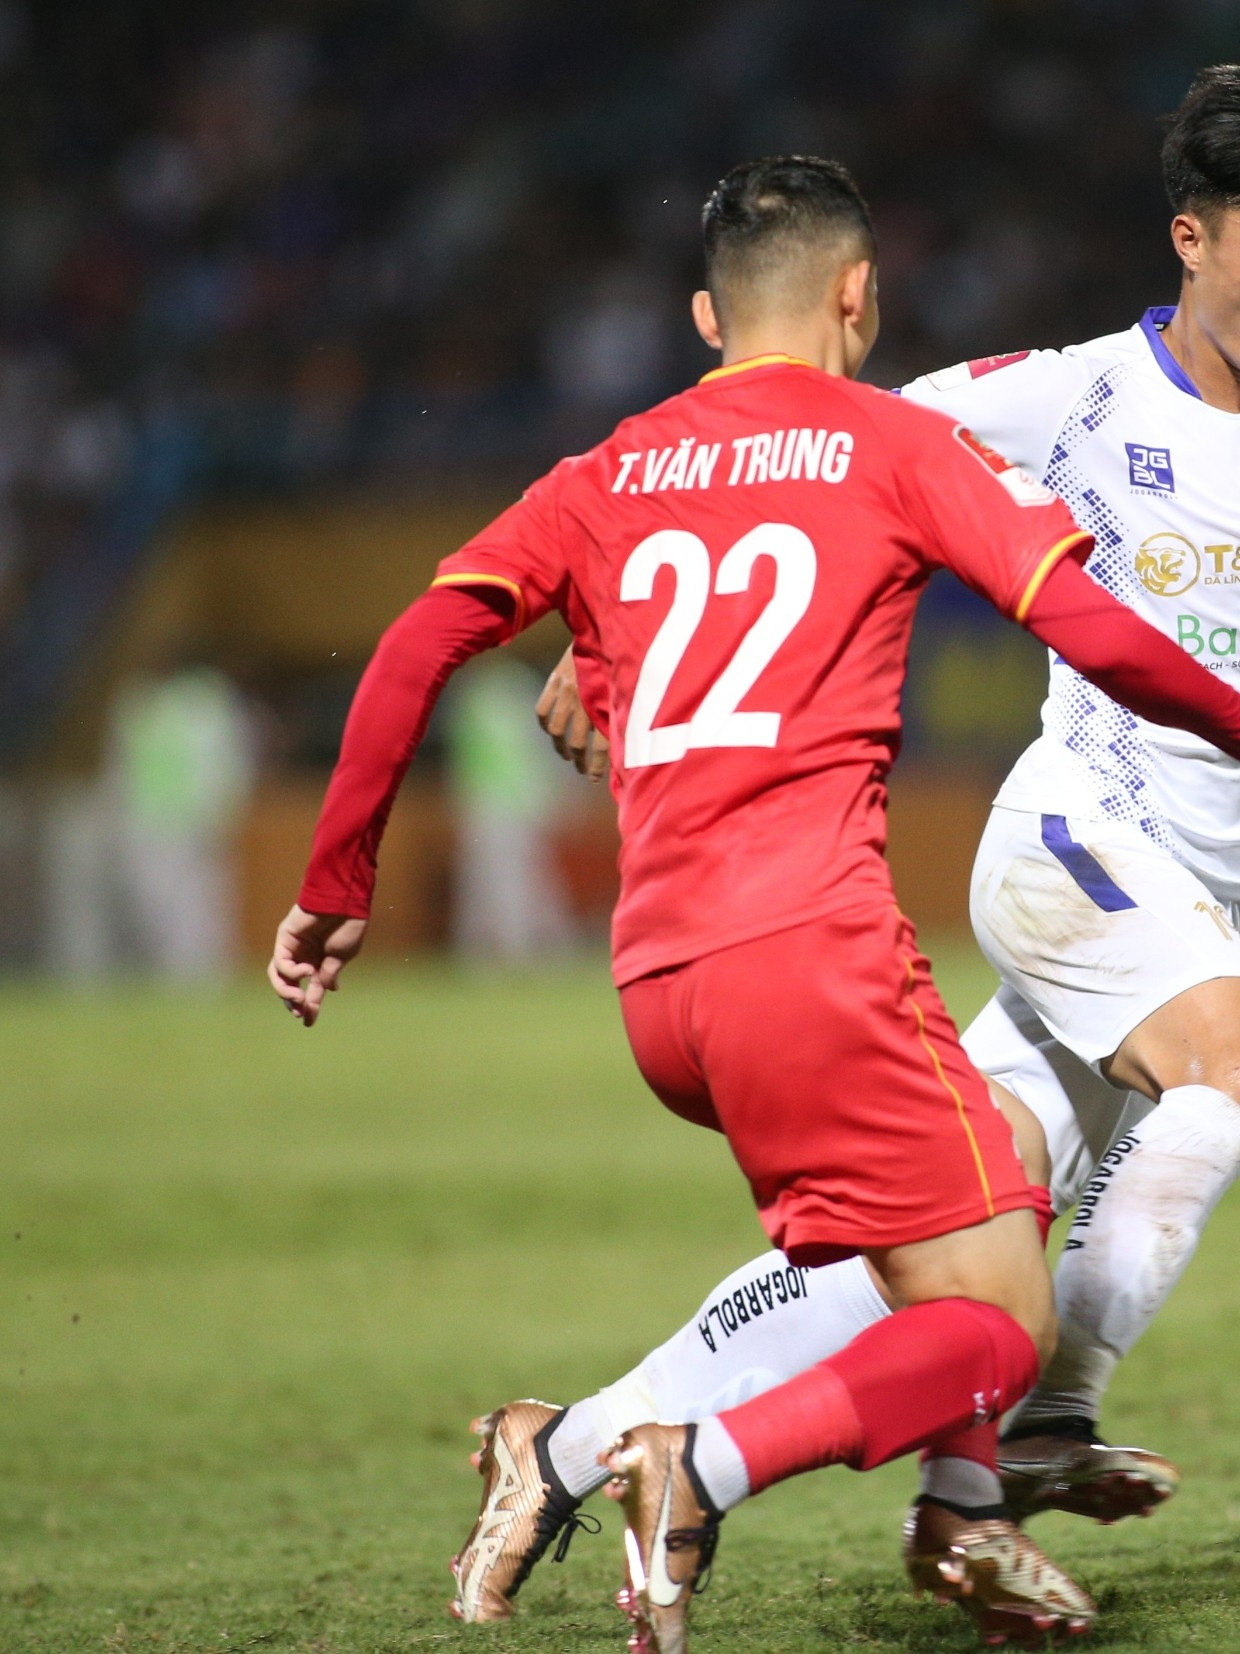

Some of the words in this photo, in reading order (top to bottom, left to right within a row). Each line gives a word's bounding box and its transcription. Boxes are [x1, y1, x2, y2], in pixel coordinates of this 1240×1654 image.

[611, 437, 721, 494] T.VĂN
[728, 428, 854, 486] TRUNG
[620, 522, 817, 769] 22
[698, 1264, 809, 1354] JOGARBOLA
